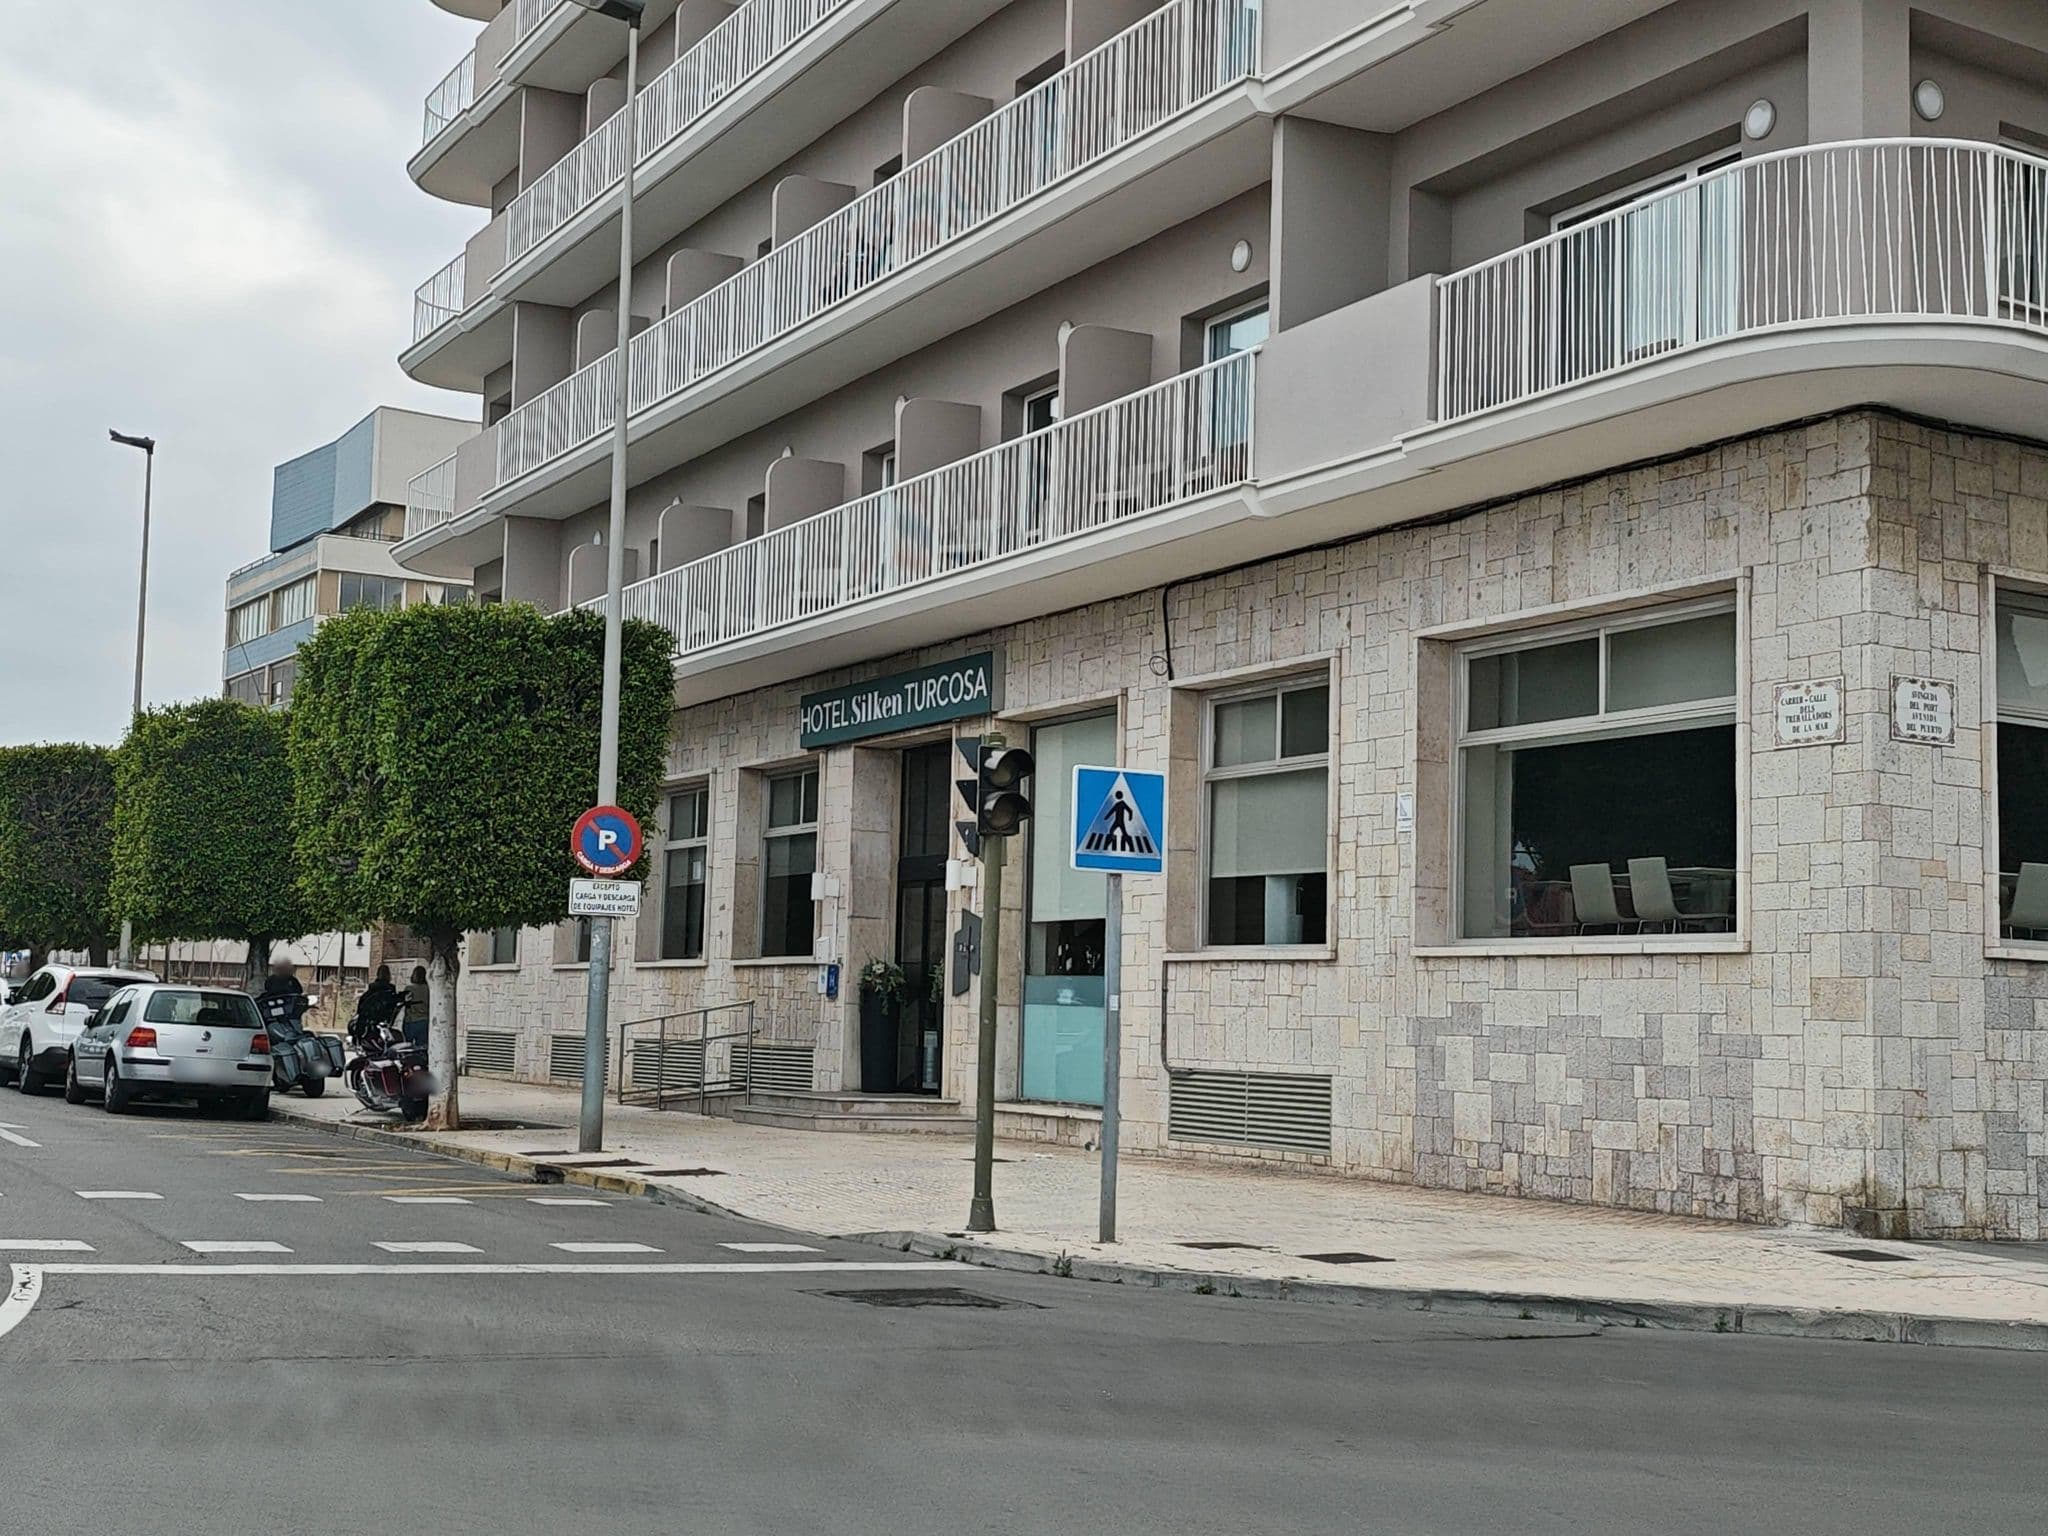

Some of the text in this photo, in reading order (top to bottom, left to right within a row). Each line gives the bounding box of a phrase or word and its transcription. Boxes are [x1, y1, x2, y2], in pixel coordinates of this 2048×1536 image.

[801, 667, 987, 735] HOTEL Silken TURCOSA
[1780, 696, 1803, 706] CARRER
[1809, 694, 1827, 703] CALLE
[1800, 705, 1815, 714] DELS
[1909, 701, 1938, 712] DEL PORT
[1785, 711, 1832, 723] TREBALLADORS
[1912, 712, 1937, 722] AVENIDA
[1804, 724, 1812, 732] LA
[1815, 722, 1828, 730] MAR
[1906, 723, 1943, 734] DEL PUERTO
[598, 829, 618, 851] P
[592, 882, 621, 891] EXCEPTO
[575, 892, 597, 900] CARGA
[603, 893, 636, 902] DESCARGA
[573, 902, 637, 912] DE EQUIPAJES HOTEL
